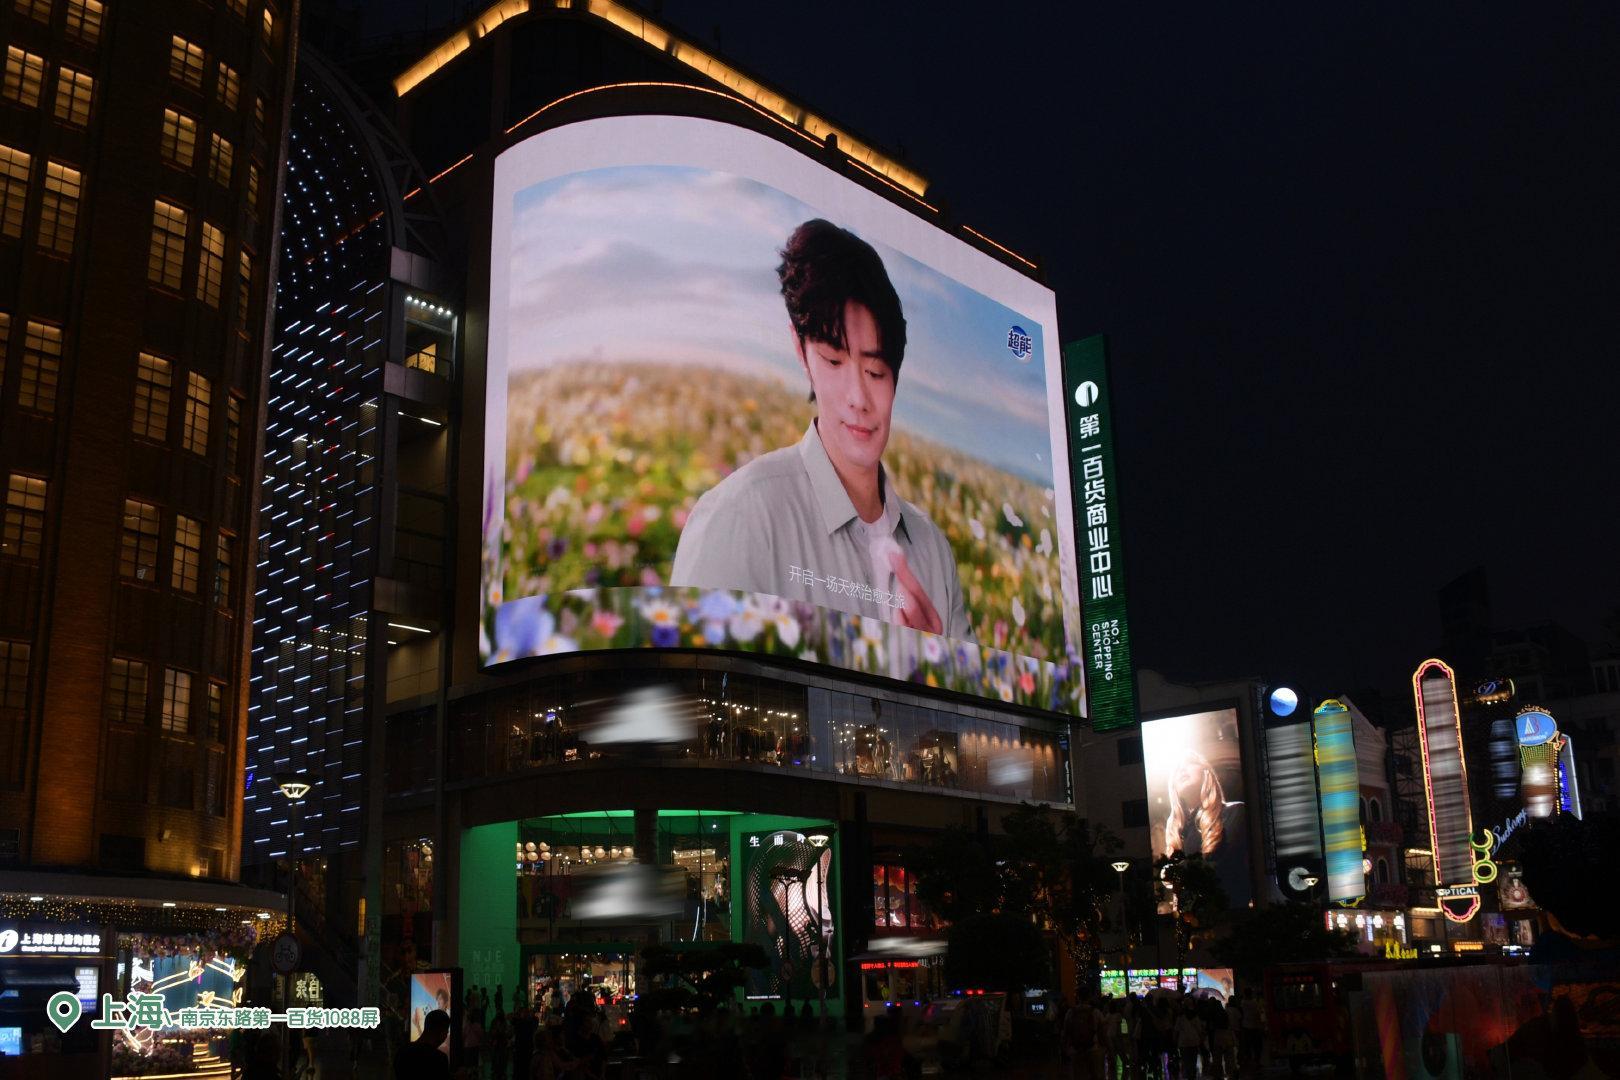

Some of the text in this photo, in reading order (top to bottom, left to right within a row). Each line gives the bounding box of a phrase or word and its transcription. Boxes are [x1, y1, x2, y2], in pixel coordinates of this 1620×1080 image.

[1008, 330, 1032, 354] 超能
[1079, 414, 1113, 600] 第一百货商业中心
[788, 565, 905, 609] 开启一场天然治愈之旅
[1092, 623, 1103, 670] CENTER
[1101, 621, 1114, 681] SHOPPING
[1110, 619, 1120, 645] NO.1
